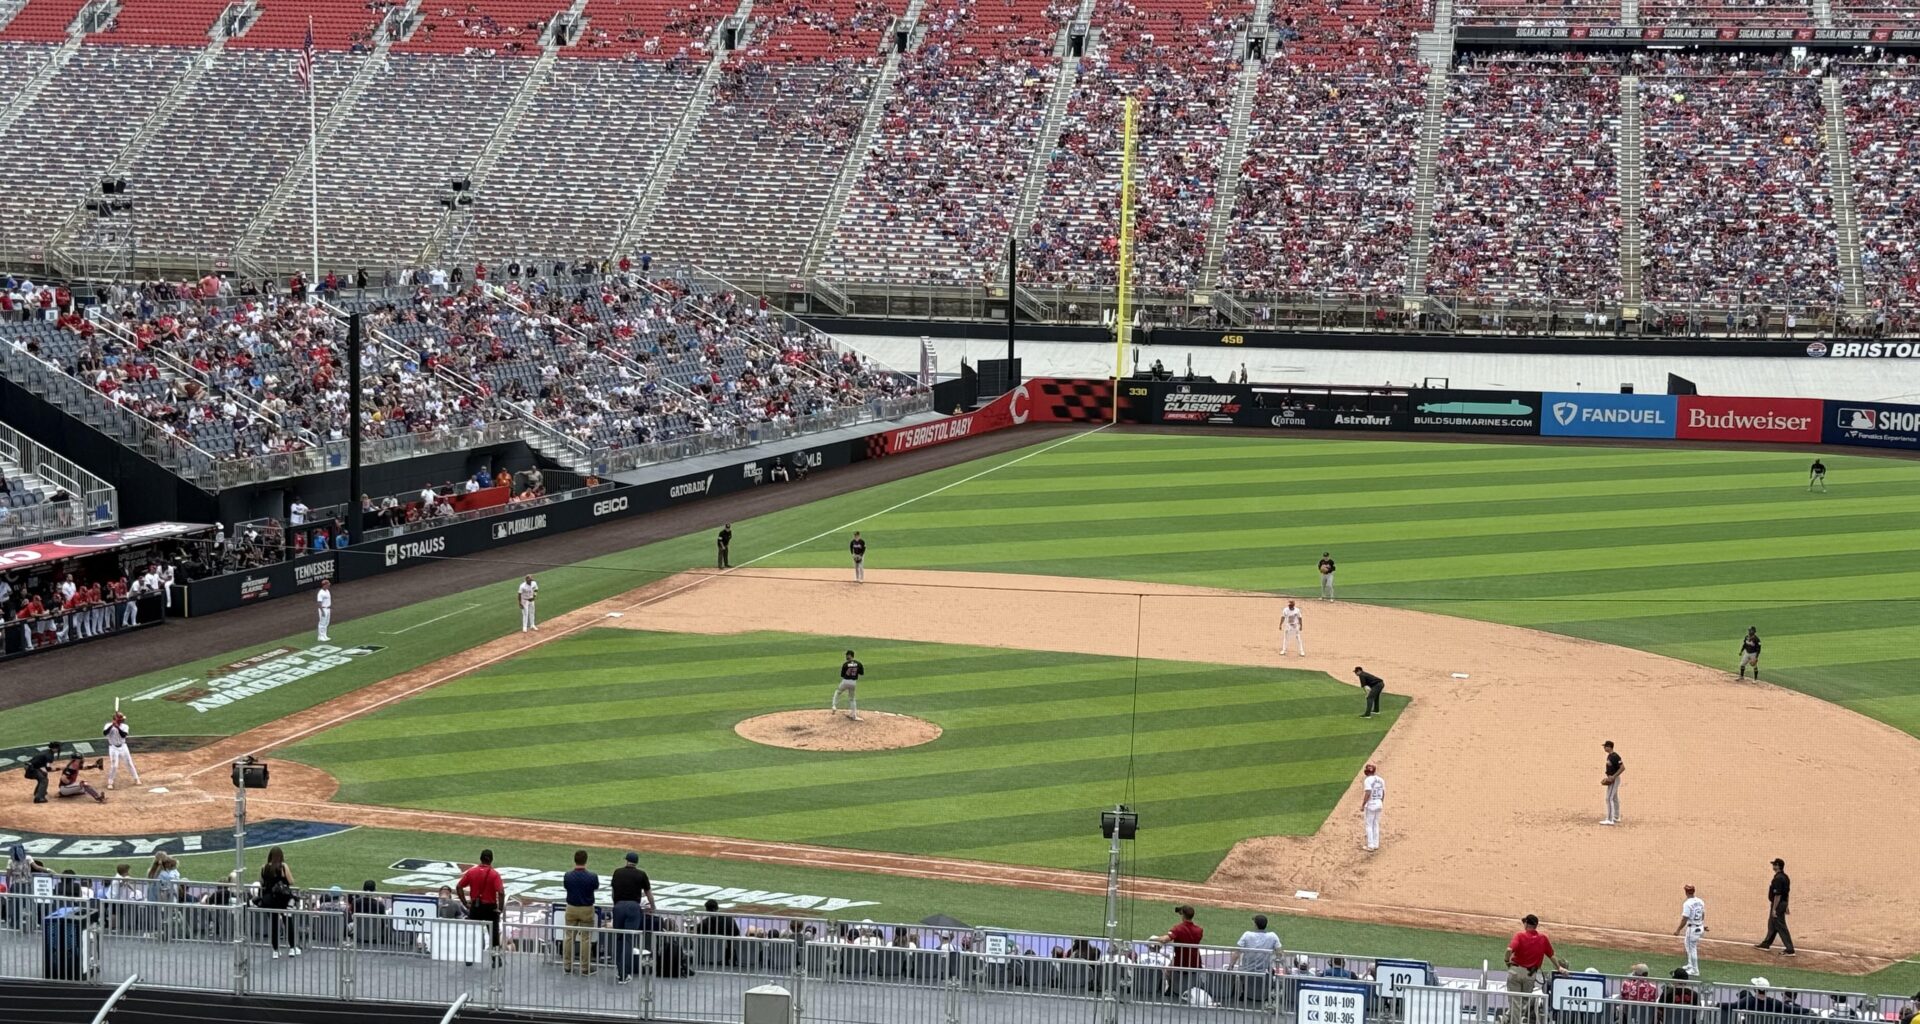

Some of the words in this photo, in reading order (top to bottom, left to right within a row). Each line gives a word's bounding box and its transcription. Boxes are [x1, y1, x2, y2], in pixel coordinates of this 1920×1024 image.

[1515, 28, 1551, 38] SUGARLANDS
[1552, 28, 1569, 38] SHINE
[1589, 28, 1625, 38] SUGARLANDS
[1626, 28, 1643, 38] SHINE
[1663, 29, 1699, 39] SUGARLANDS
[1700, 29, 1717, 39] SHINE
[1738, 29, 1775, 39] SUGARLANDS
[1776, 29, 1793, 39] SHINE
[1814, 30, 1851, 39] SUGARLANDS
[1853, 30, 1870, 39] SHINE
[1221, 335, 1243, 344] 458
[1830, 343, 1920, 357] BRISTOL
[1129, 388, 1147, 396] 330
[1164, 393, 1236, 404] SPEEDWAY
[1163, 402, 1221, 412] CLASSIC
[1271, 415, 1306, 427] Corona
[1413, 417, 1533, 427] BUILDSUBMARINES.COM
[1582, 408, 1665, 424] FANDUEL
[1688, 408, 1812, 431] Budweiser
[894, 430, 912, 450] IT'S
[912, 422, 950, 447] BRISTOL
[949, 416, 973, 437] BABY
[670, 480, 705, 498] GATORADE
[593, 496, 628, 516] GEICO
[508, 514, 547, 536] PLAYBALL.ORG
[400, 536, 445, 559] STRAUSS
[294, 559, 335, 580] TENNESSEE
[207, 644, 343, 690] CLASSIC
[187, 655, 353, 713] SPEEDWAY
[1324, 995, 1355, 1008] 104-109
[1567, 986, 1588, 1005] 101
[1323, 1011, 1355, 1024] 301-305
